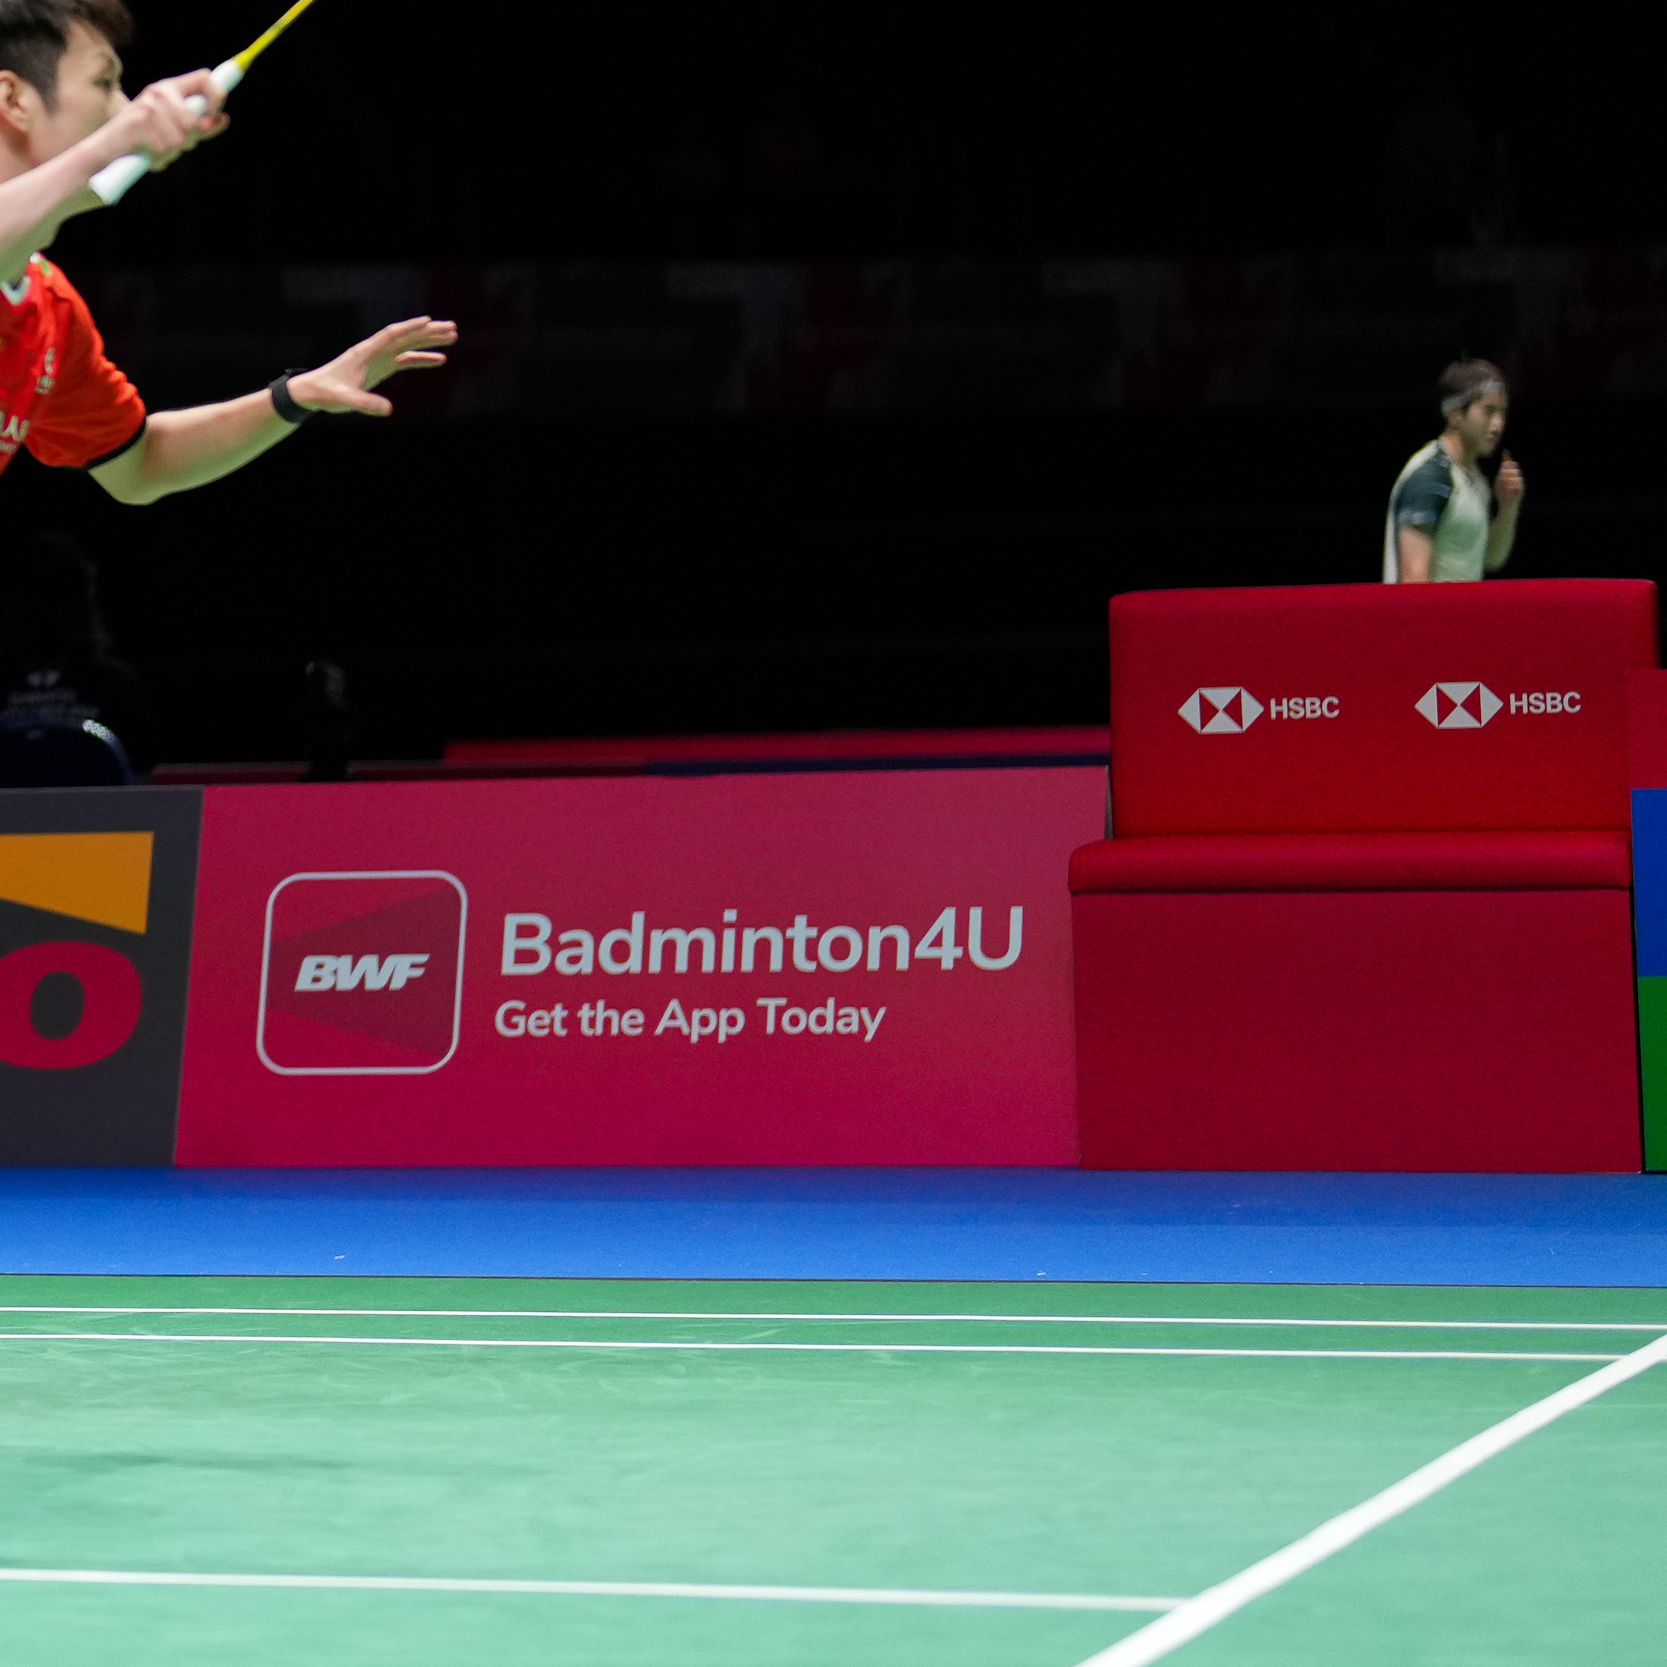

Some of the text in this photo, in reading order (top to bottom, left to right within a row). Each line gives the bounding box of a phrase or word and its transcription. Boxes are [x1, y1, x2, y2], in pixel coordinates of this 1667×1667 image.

[1270, 697, 1340, 720] HSBC
[1509, 691, 1581, 715] HSBC
[501, 905, 1024, 976] Badminton4U
[294, 953, 430, 992] BWF
[495, 997, 887, 1044] Get the App Today
